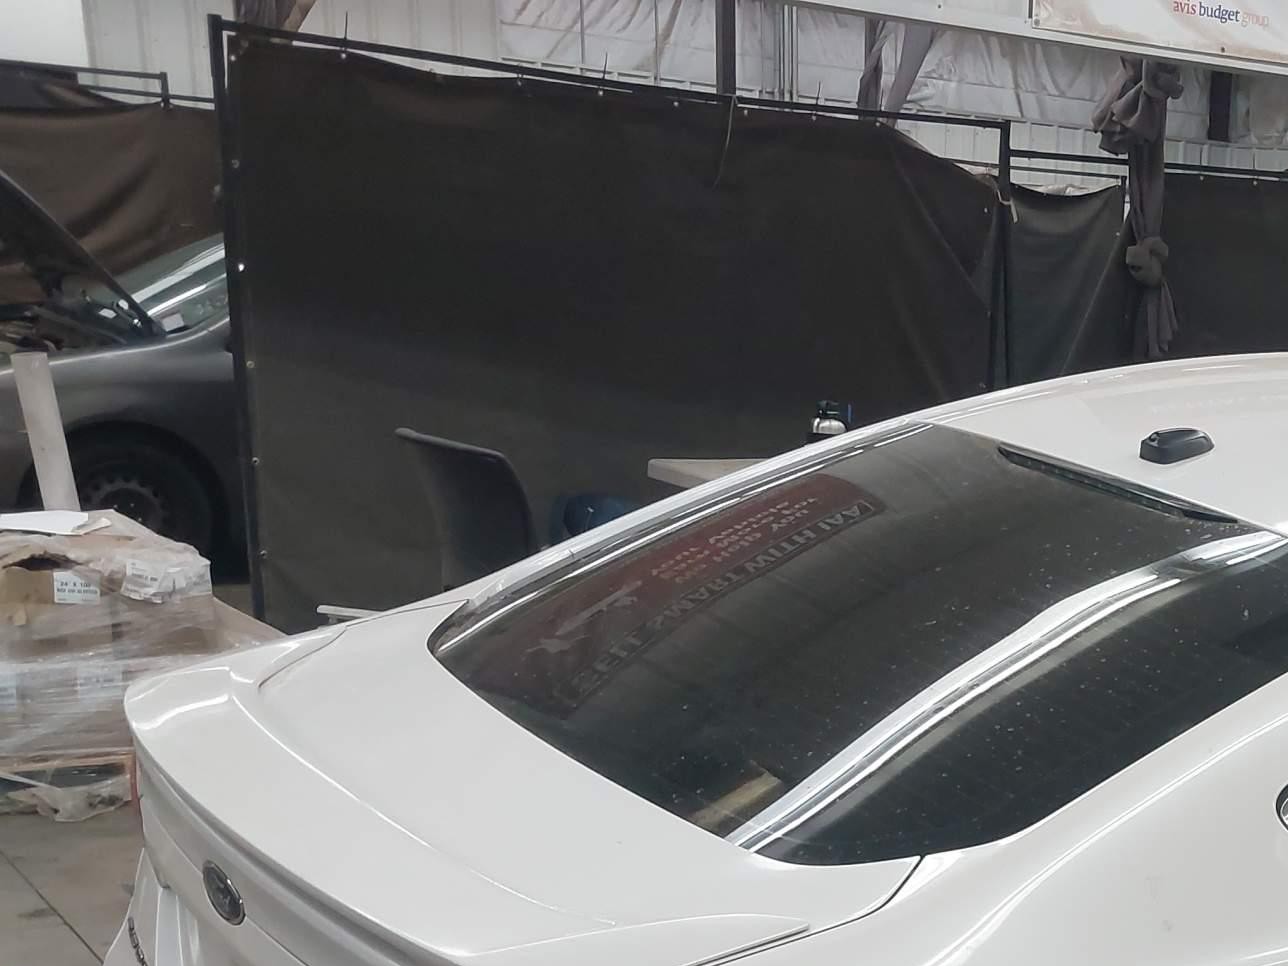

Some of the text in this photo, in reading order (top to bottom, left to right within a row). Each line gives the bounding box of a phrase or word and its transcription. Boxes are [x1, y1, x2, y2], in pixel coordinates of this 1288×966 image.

[1172, 0, 1270, 31] avis budget group
